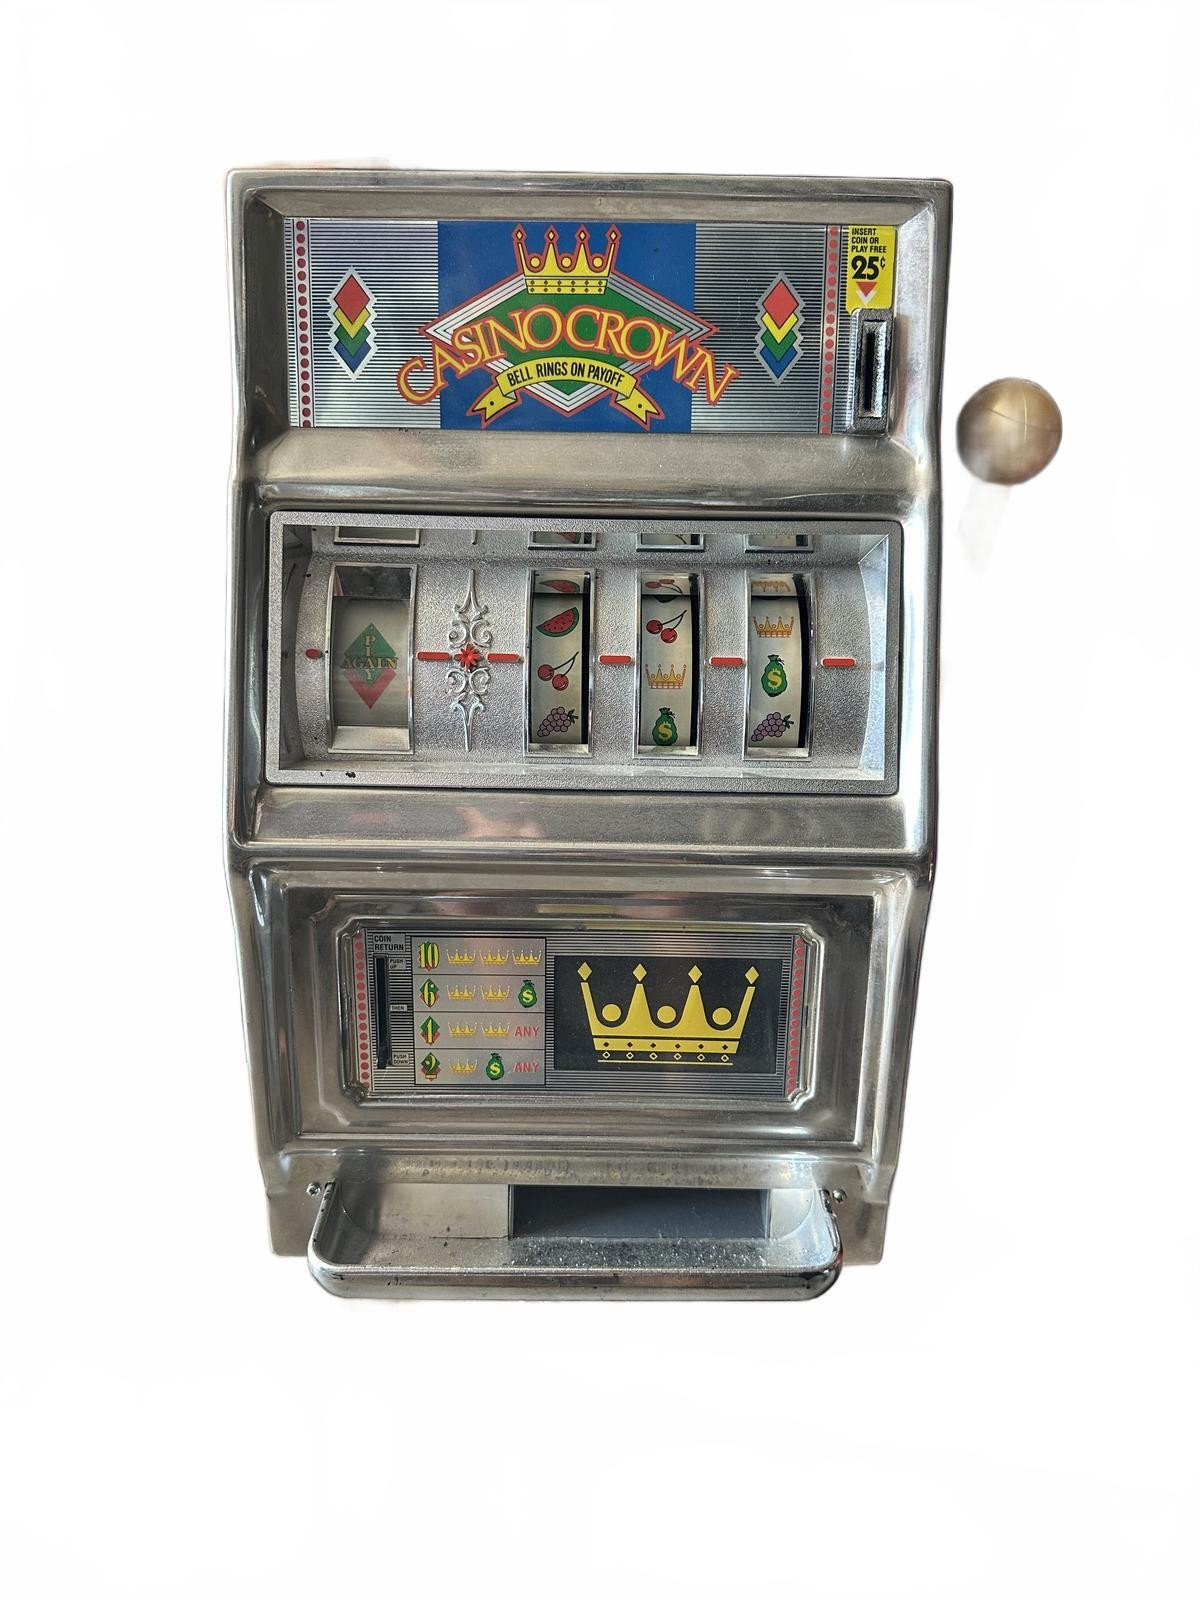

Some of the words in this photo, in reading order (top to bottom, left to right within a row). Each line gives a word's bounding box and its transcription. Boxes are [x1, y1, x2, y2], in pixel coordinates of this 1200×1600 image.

[851, 227, 877, 236] INSERT
[851, 236, 868, 244] COIN
[869, 236, 880, 244] OR
[851, 245, 868, 253] PLAY
[869, 245, 887, 253] FREE
[397, 304, 564, 406] CASINO
[564, 305, 741, 407] CROWN
[507, 366, 533, 387] BELL
[536, 361, 568, 378] RINGS
[570, 362, 585, 377] ON
[587, 365, 625, 387] PAYOFF
[341, 657, 399, 669] AGAIN
[374, 943, 404, 951] RETURN
[514, 1026, 539, 1037] ANY
[514, 1062, 539, 1073] ANY
